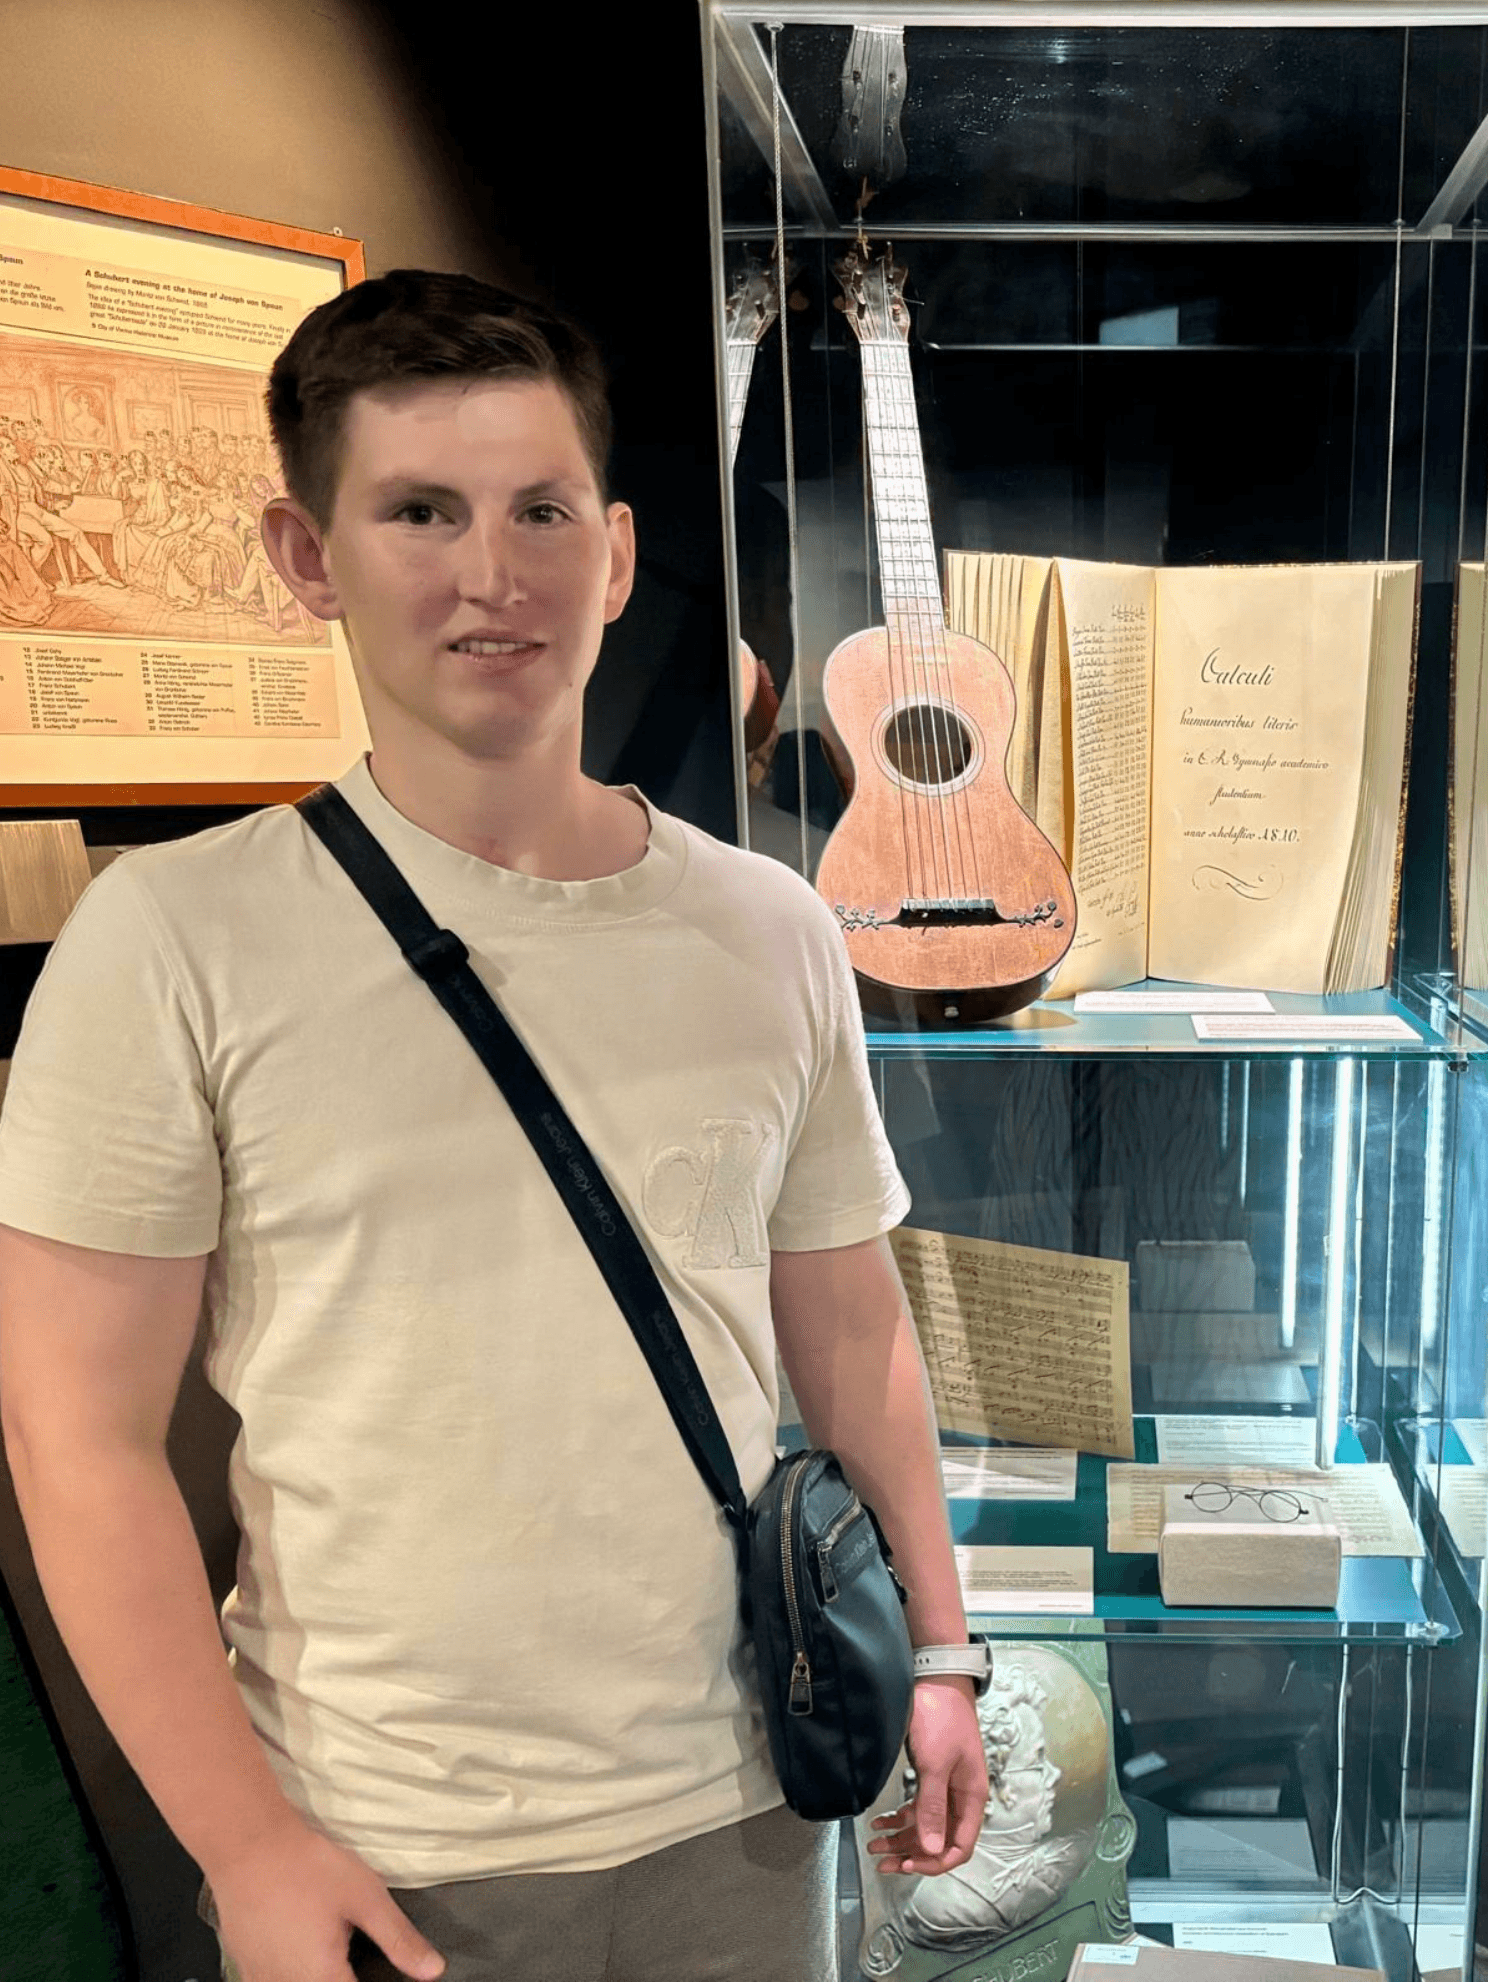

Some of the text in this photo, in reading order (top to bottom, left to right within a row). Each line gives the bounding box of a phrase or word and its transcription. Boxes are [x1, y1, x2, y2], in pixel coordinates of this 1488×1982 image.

[94, 271, 129, 283] Schubert
[132, 279, 160, 290] evening
[188, 287, 207, 297] home
[219, 294, 244, 304] Joseph
[1201, 647, 1274, 686] Calculi
[565, 1156, 592, 1193] Klein
[584, 1189, 617, 1238] Calvin
